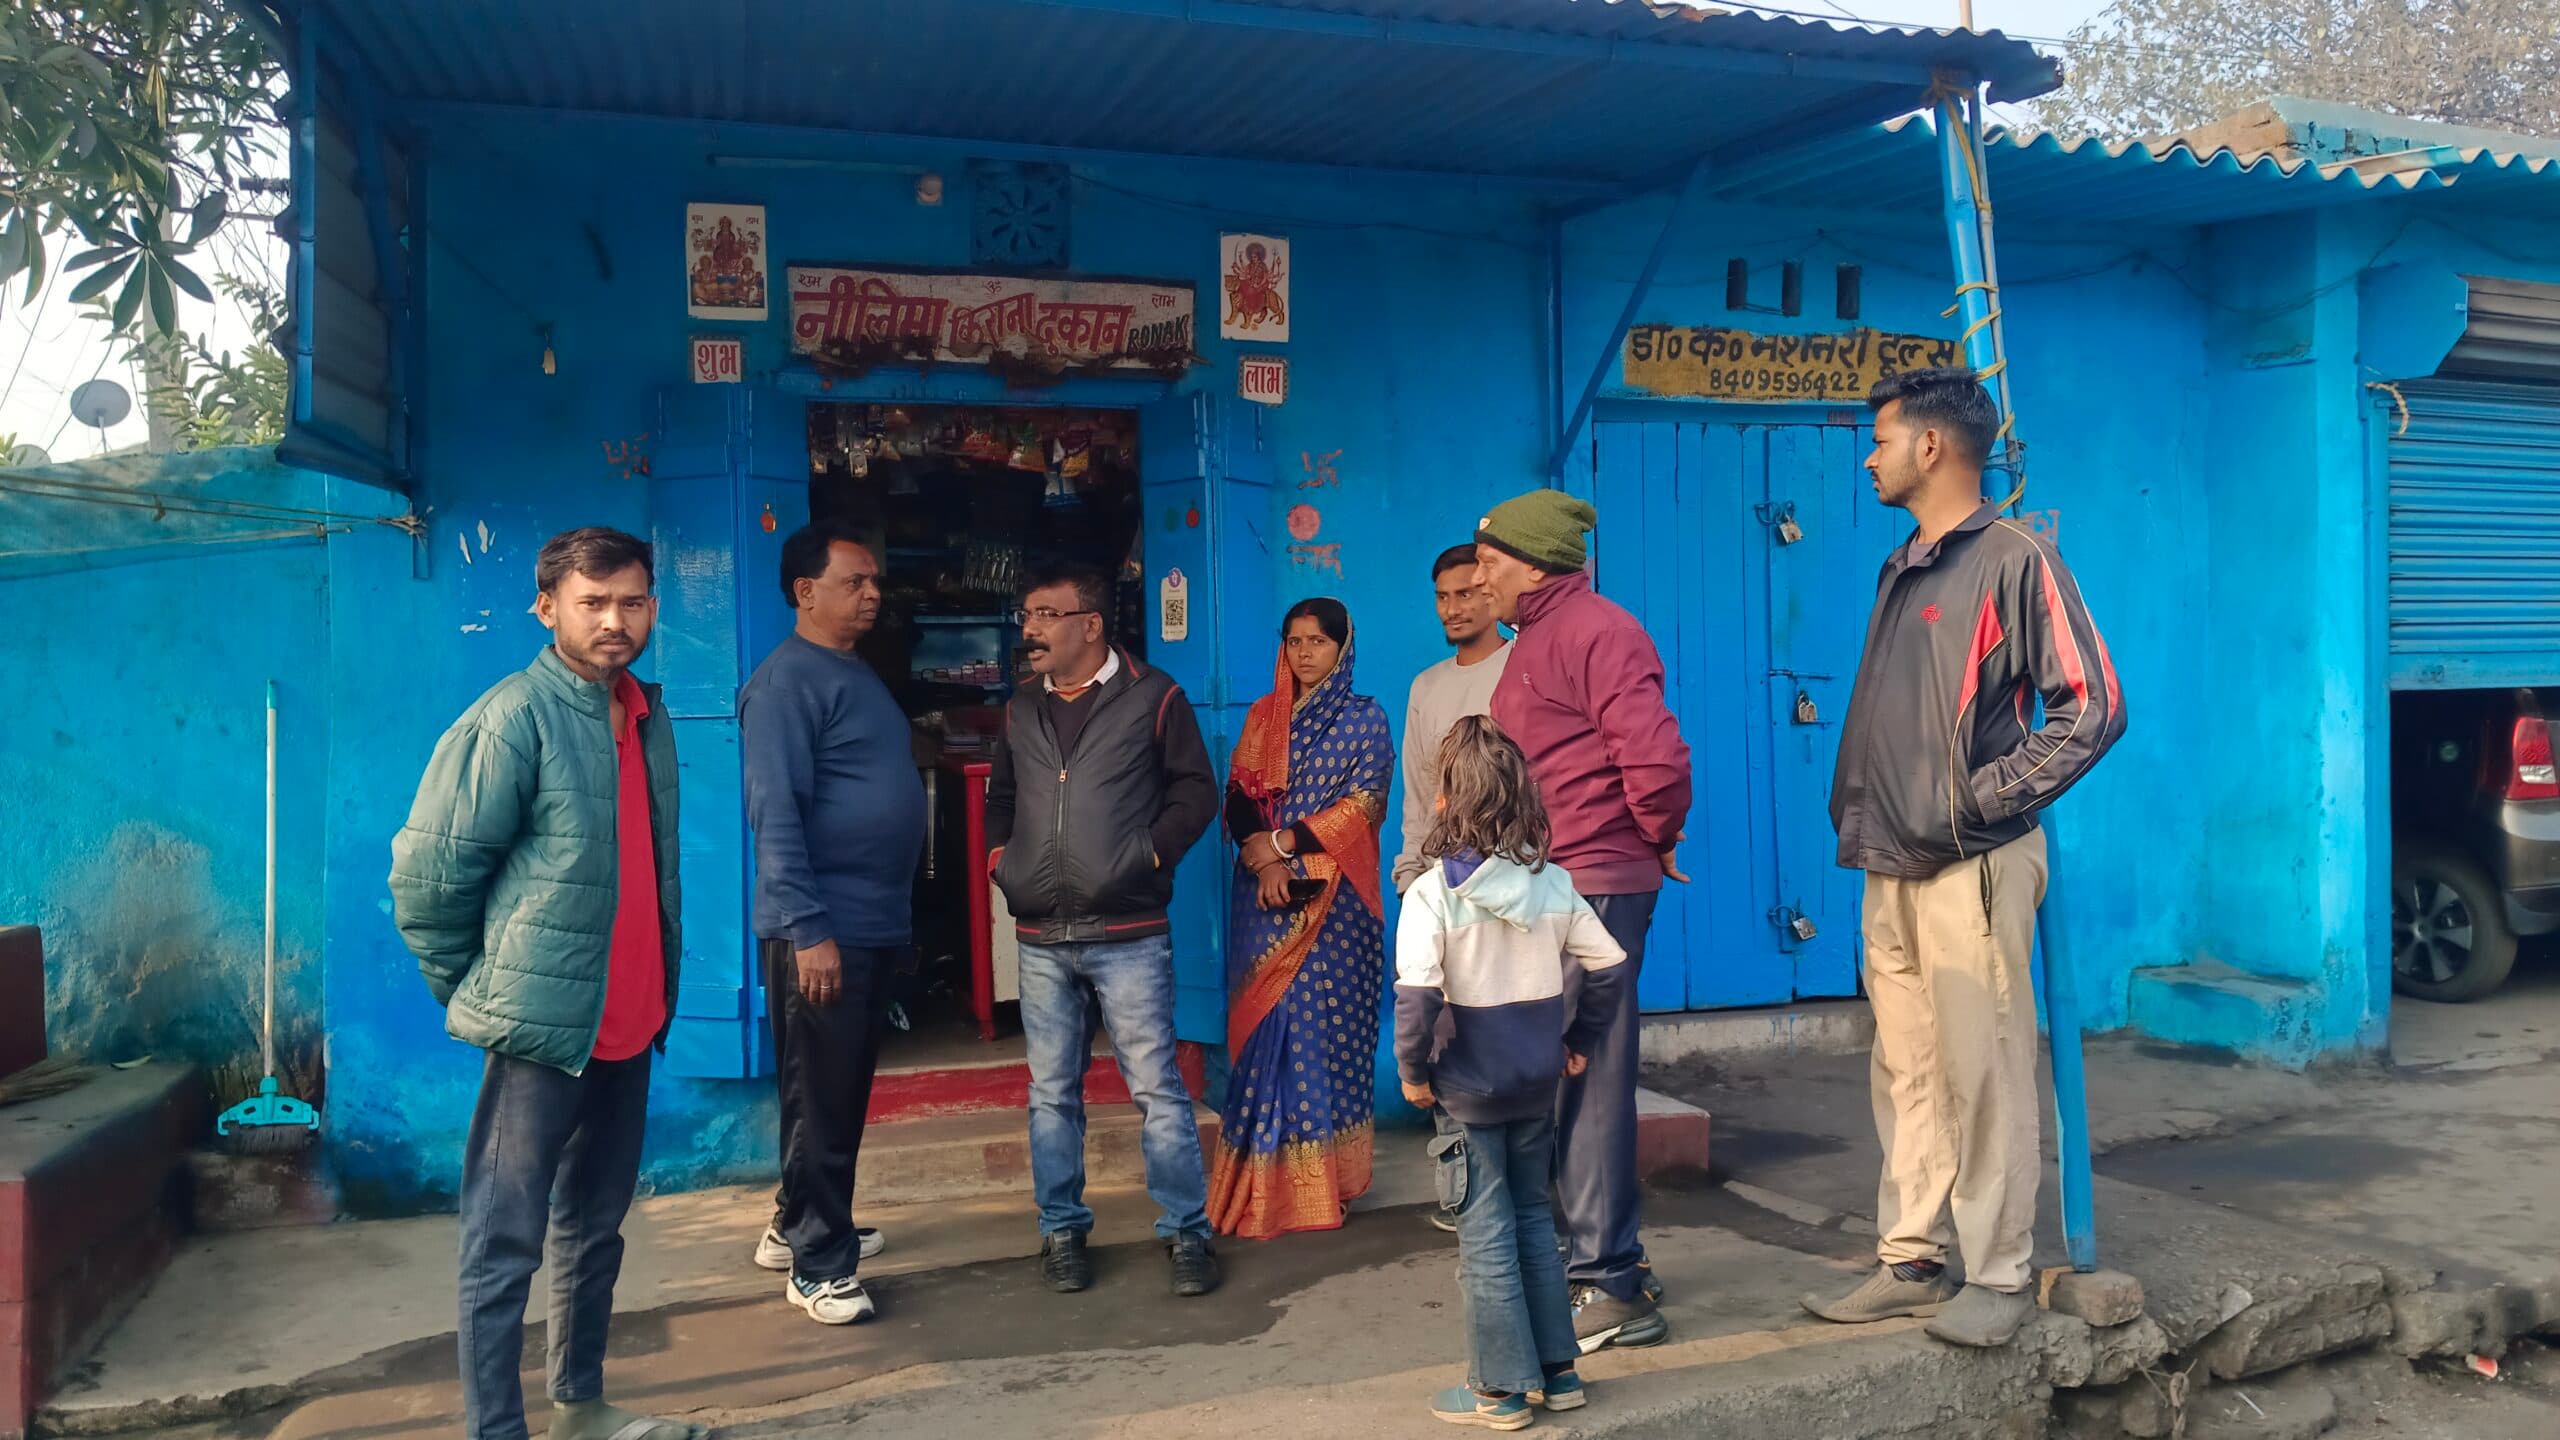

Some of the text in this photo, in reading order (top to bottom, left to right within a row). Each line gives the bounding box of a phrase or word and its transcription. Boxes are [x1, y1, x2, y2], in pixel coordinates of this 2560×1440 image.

[1127, 313, 1190, 354] RONAK
[697, 343, 739, 382] शुभ
[1245, 364, 1282, 394] लाभ
[1710, 368, 1861, 400] 8409596422
